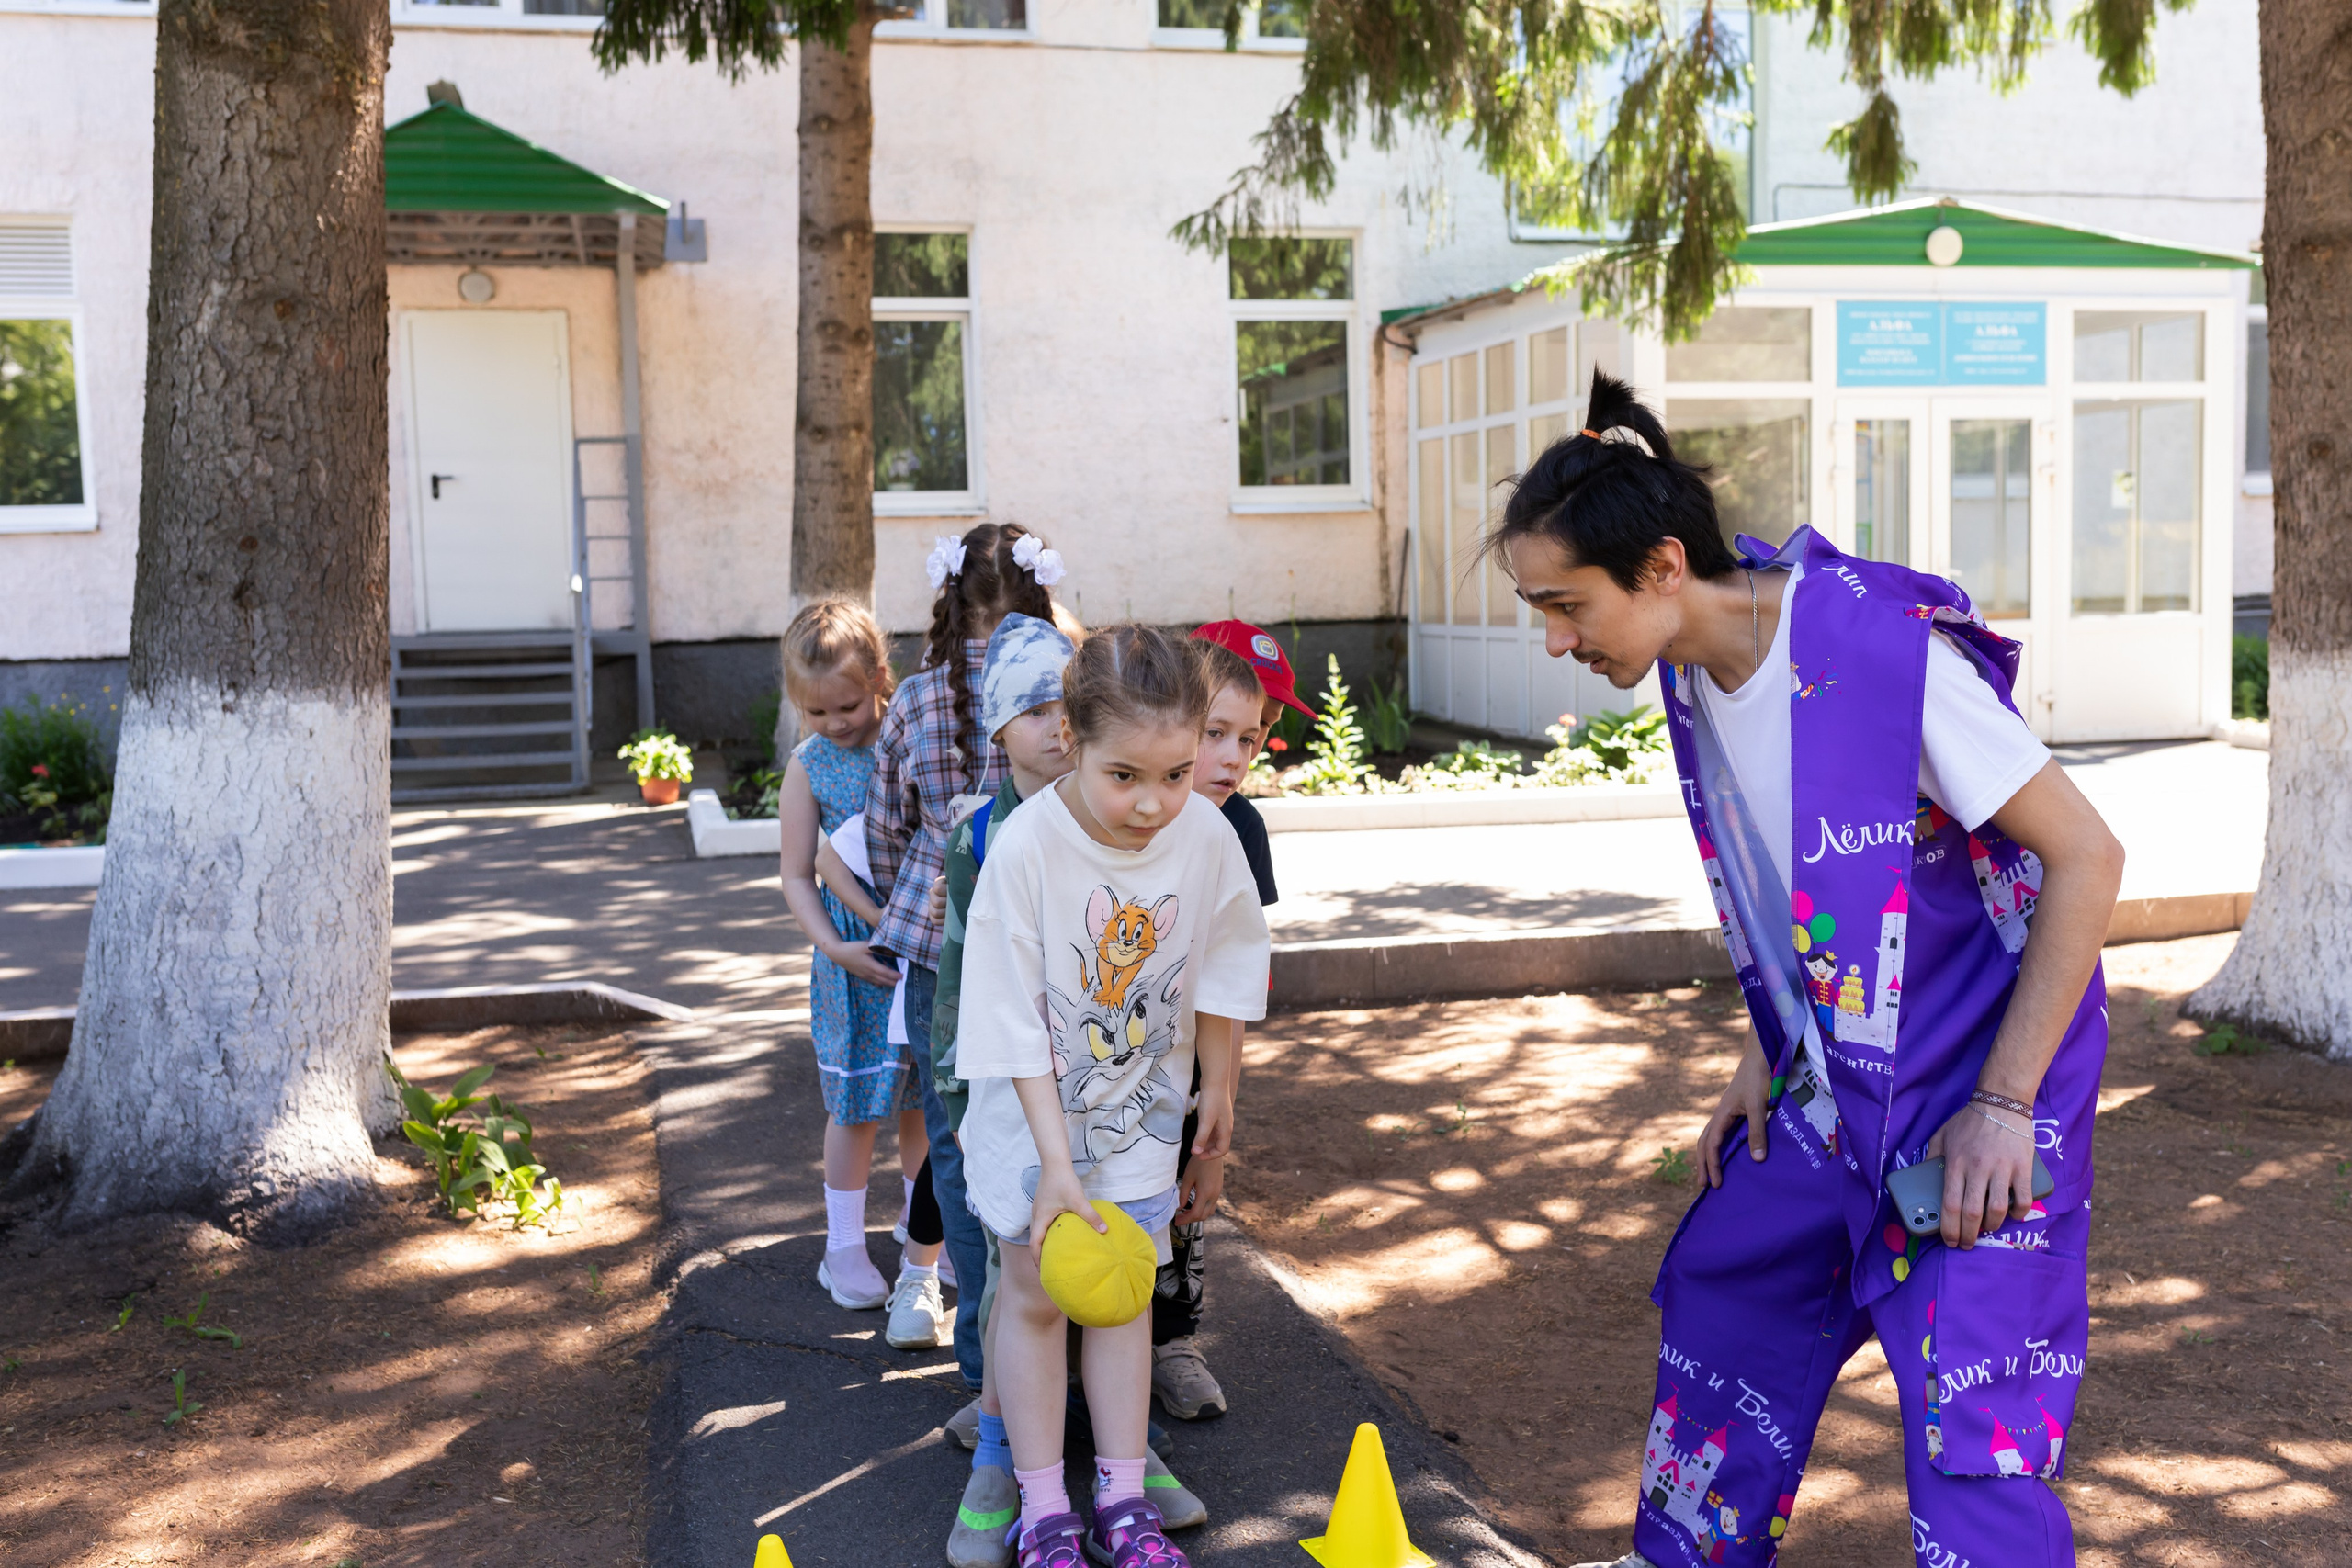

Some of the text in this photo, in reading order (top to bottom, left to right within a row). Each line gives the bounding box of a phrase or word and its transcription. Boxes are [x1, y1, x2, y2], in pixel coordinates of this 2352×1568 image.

[1802, 816, 1916, 863] Лёлик
[1659, 1335, 1702, 1379] лик
[2025, 1337, 2086, 1379] Боли
